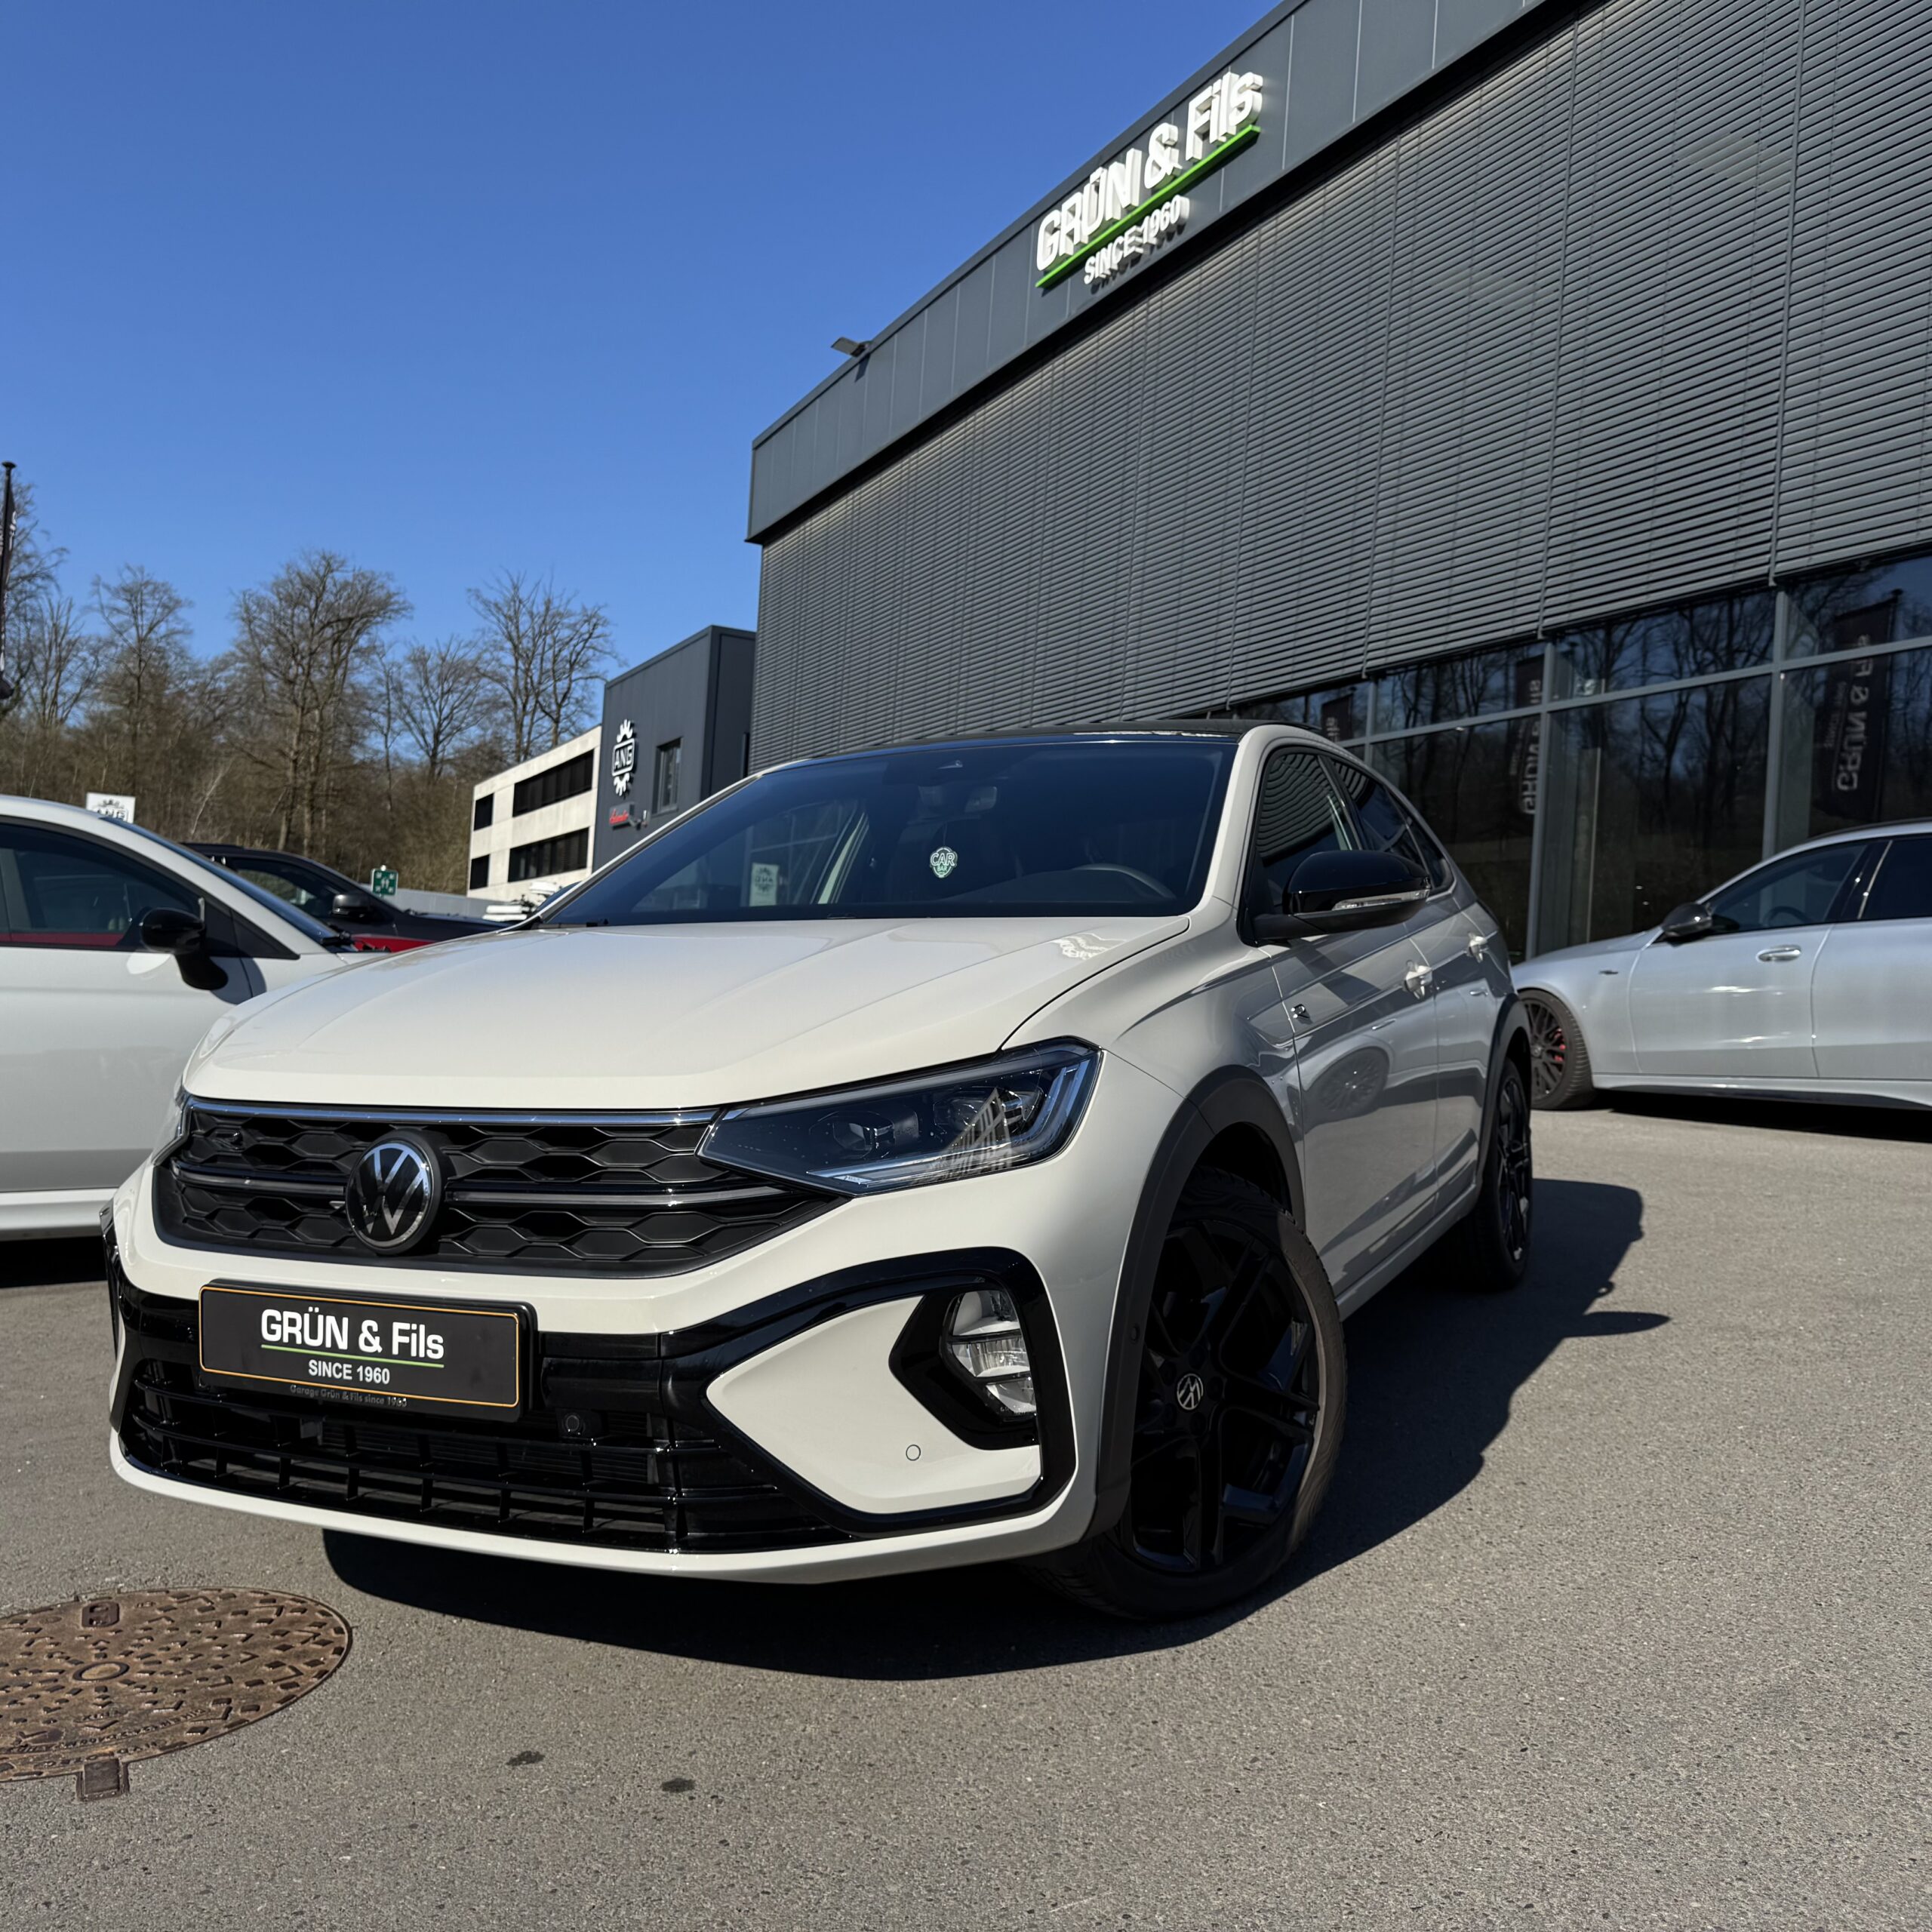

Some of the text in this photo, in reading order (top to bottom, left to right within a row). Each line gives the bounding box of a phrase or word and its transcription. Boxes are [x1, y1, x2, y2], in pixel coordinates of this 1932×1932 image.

[1036, 71, 1263, 272] GRÜN & Fils
[1084, 195, 1190, 285] SINCE 1960
[931, 852, 955, 866] CAR
[261, 1306, 445, 1359] GRÜN & Fils
[308, 1359, 391, 1385] SINCE 1960
[290, 1384, 319, 1398] Garage
[342, 1391, 349, 1401] &
[365, 1393, 385, 1405] since
